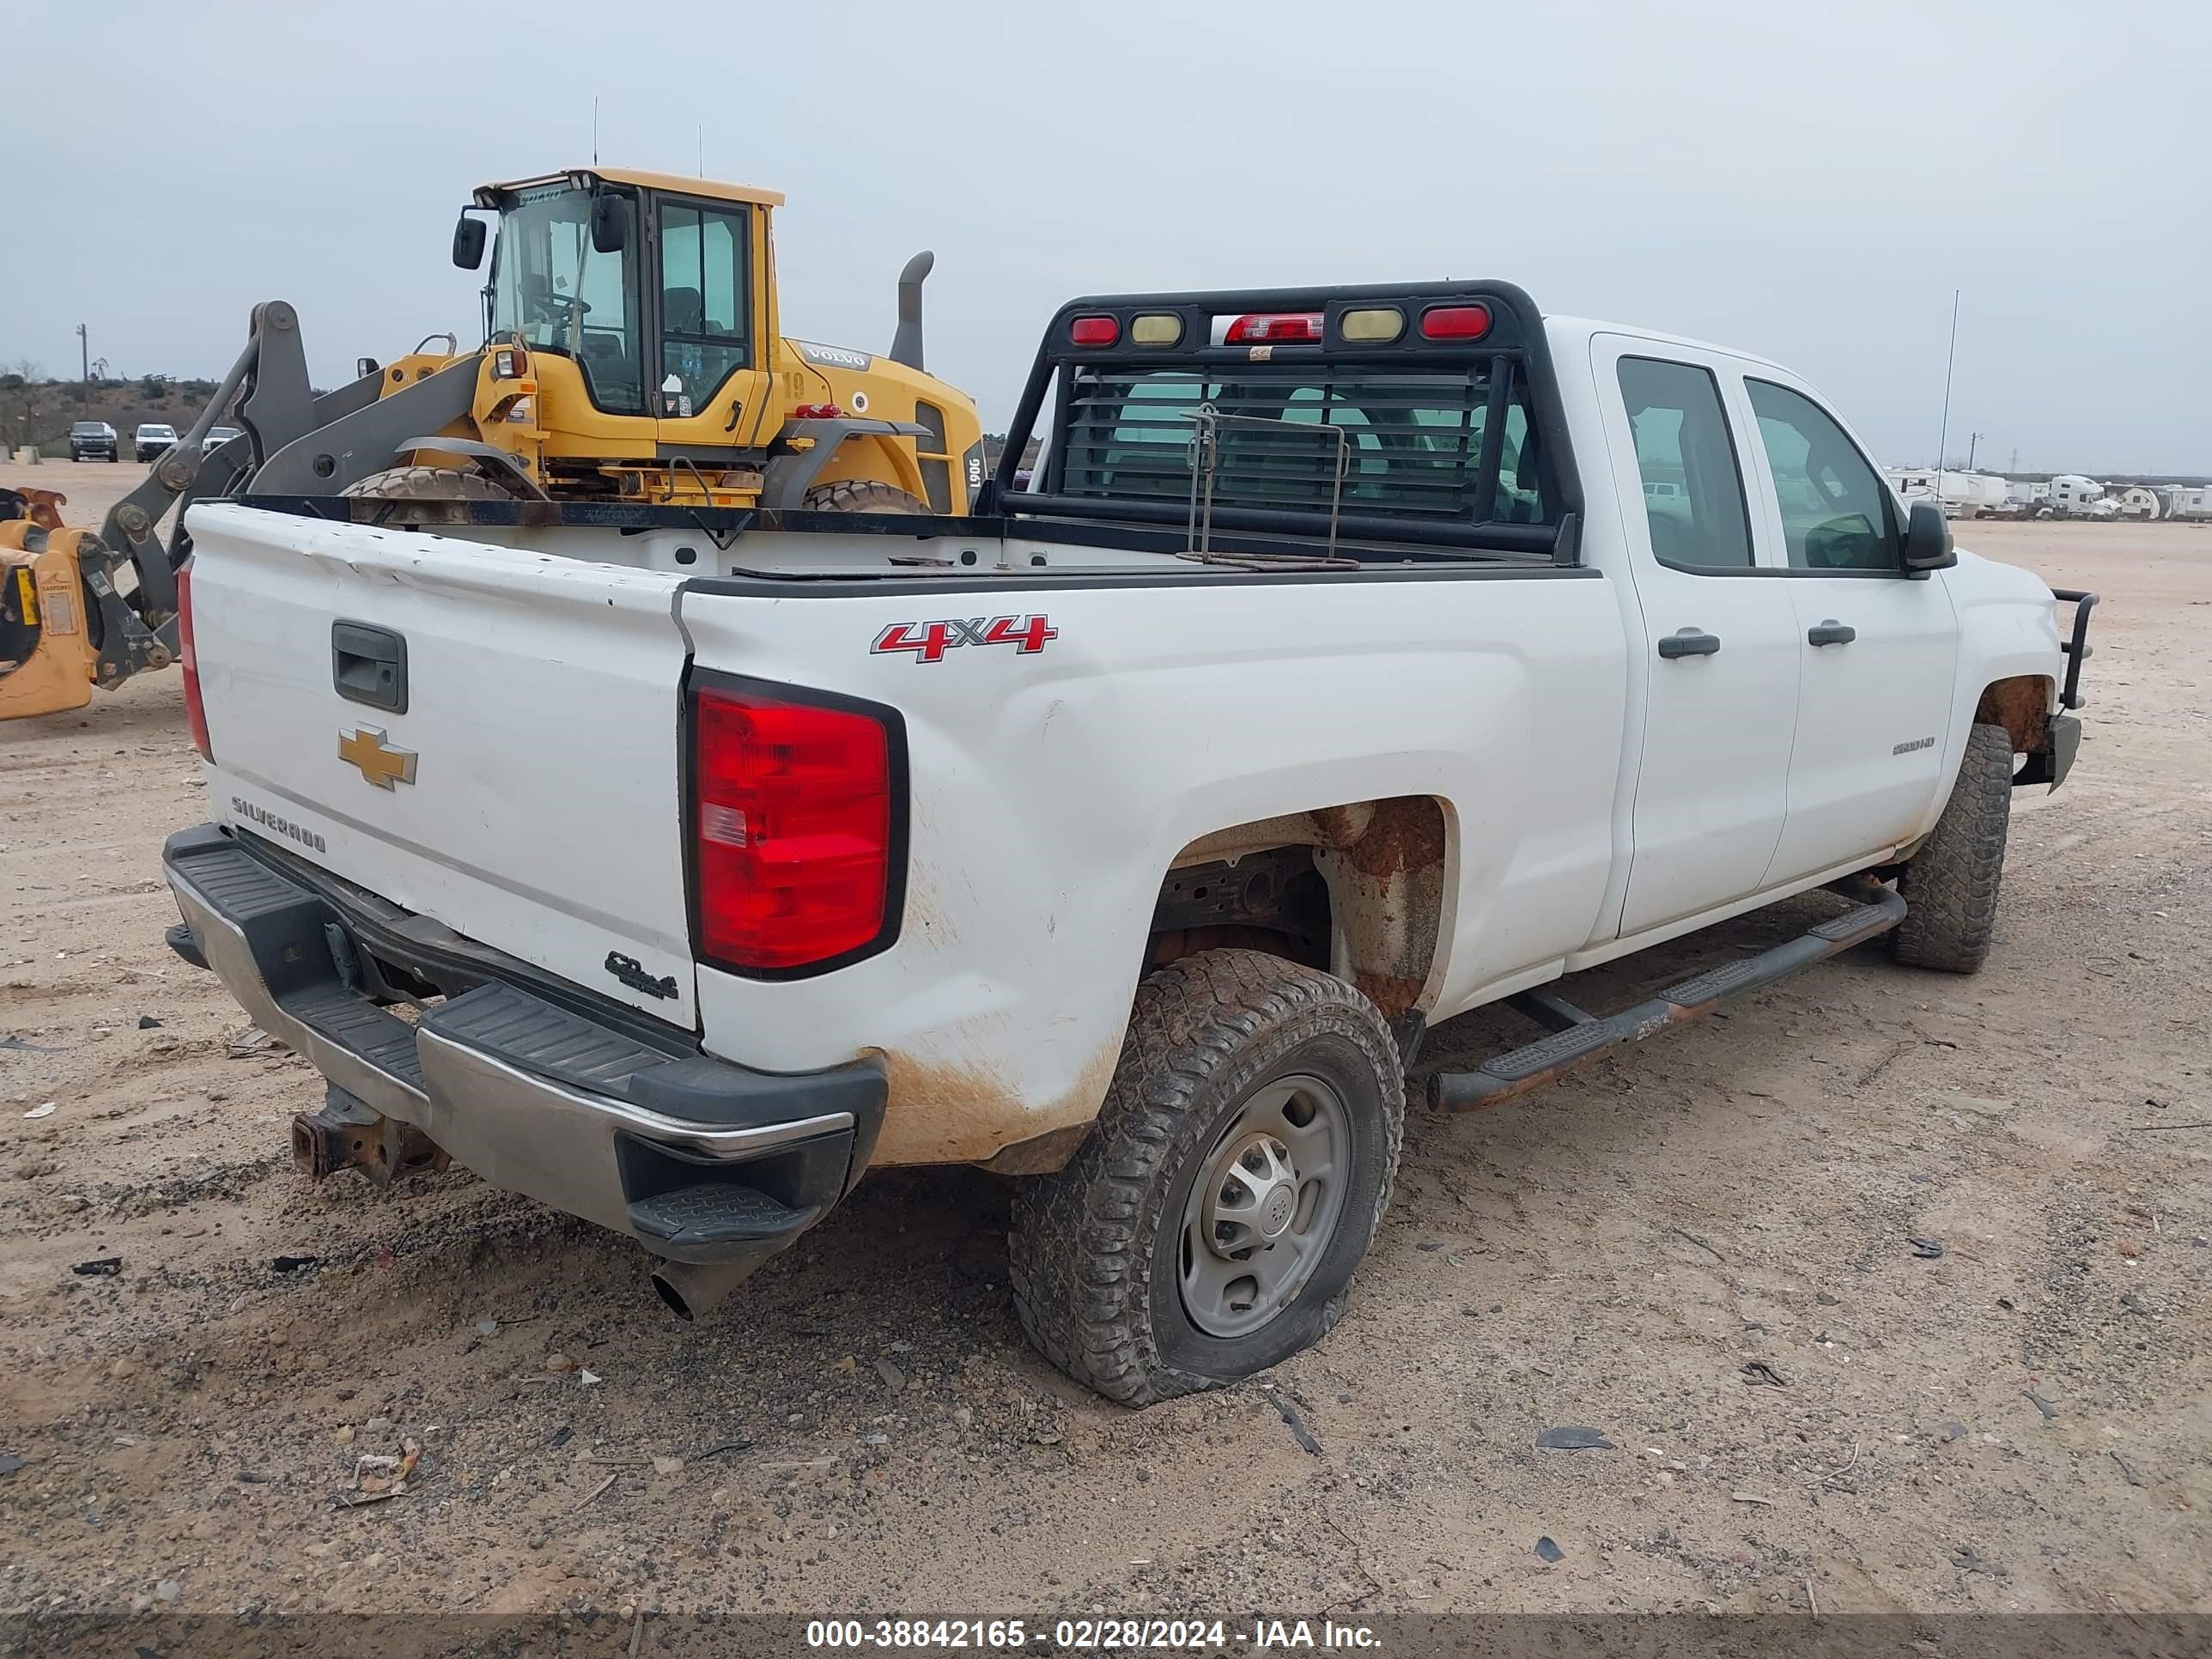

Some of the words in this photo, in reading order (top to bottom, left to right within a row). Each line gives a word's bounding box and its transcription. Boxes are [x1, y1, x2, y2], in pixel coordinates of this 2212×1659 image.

[520, 190, 562, 206] VOLVO
[805, 348, 866, 366] VOLVO
[969, 458, 981, 488] L90G
[232, 796, 326, 854] SILVERADO
